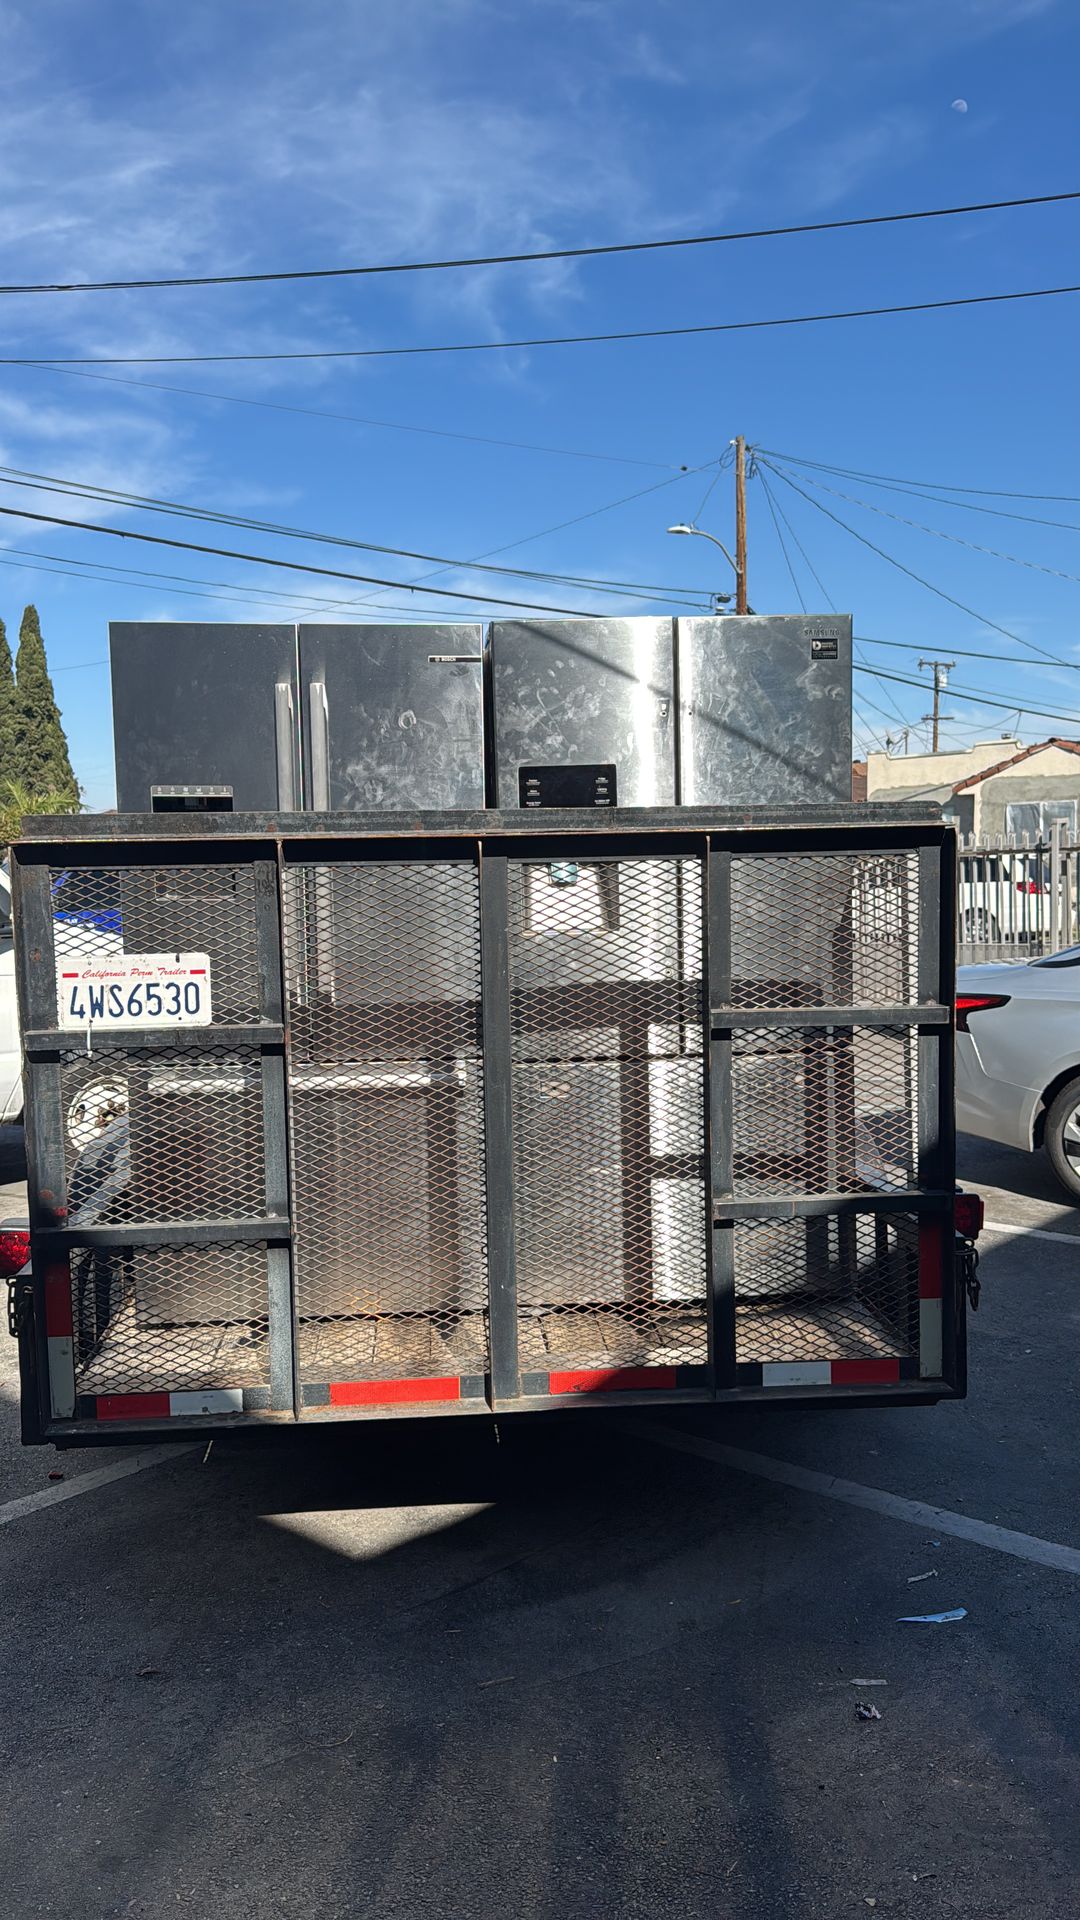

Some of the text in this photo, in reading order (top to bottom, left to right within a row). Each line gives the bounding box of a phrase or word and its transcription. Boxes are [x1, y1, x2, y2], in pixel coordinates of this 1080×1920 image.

[804, 628, 840, 637] SAMSUNG
[82, 967, 187, 980] California Perm Trailer
[70, 982, 200, 1019] 4WS6530
